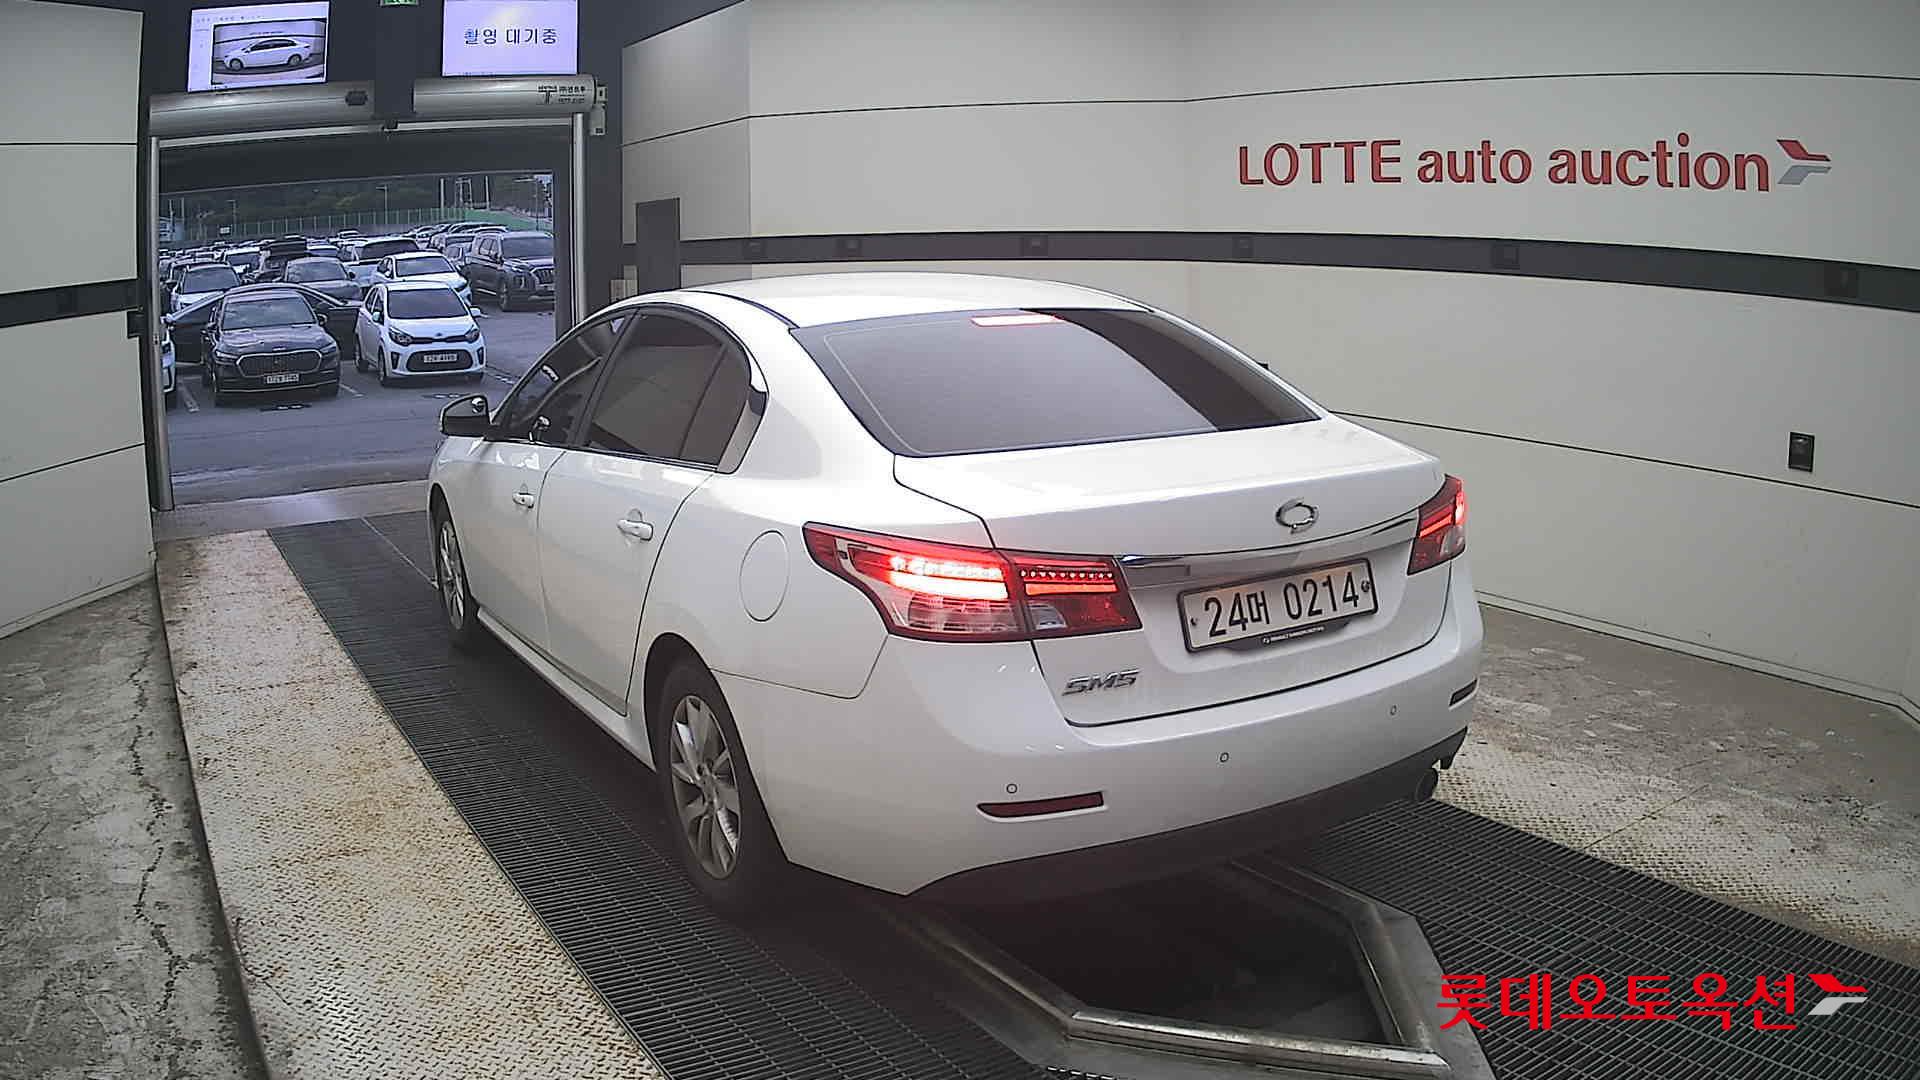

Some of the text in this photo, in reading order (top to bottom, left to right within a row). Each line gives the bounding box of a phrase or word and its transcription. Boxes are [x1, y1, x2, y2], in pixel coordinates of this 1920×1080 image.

[506, 28, 557, 45] 대기중
[1239, 132, 1770, 192] LOTTE auto auction
[1204, 590, 1270, 639] 24머
[1283, 571, 1360, 620] 0214
[1062, 668, 1140, 696] SM5
